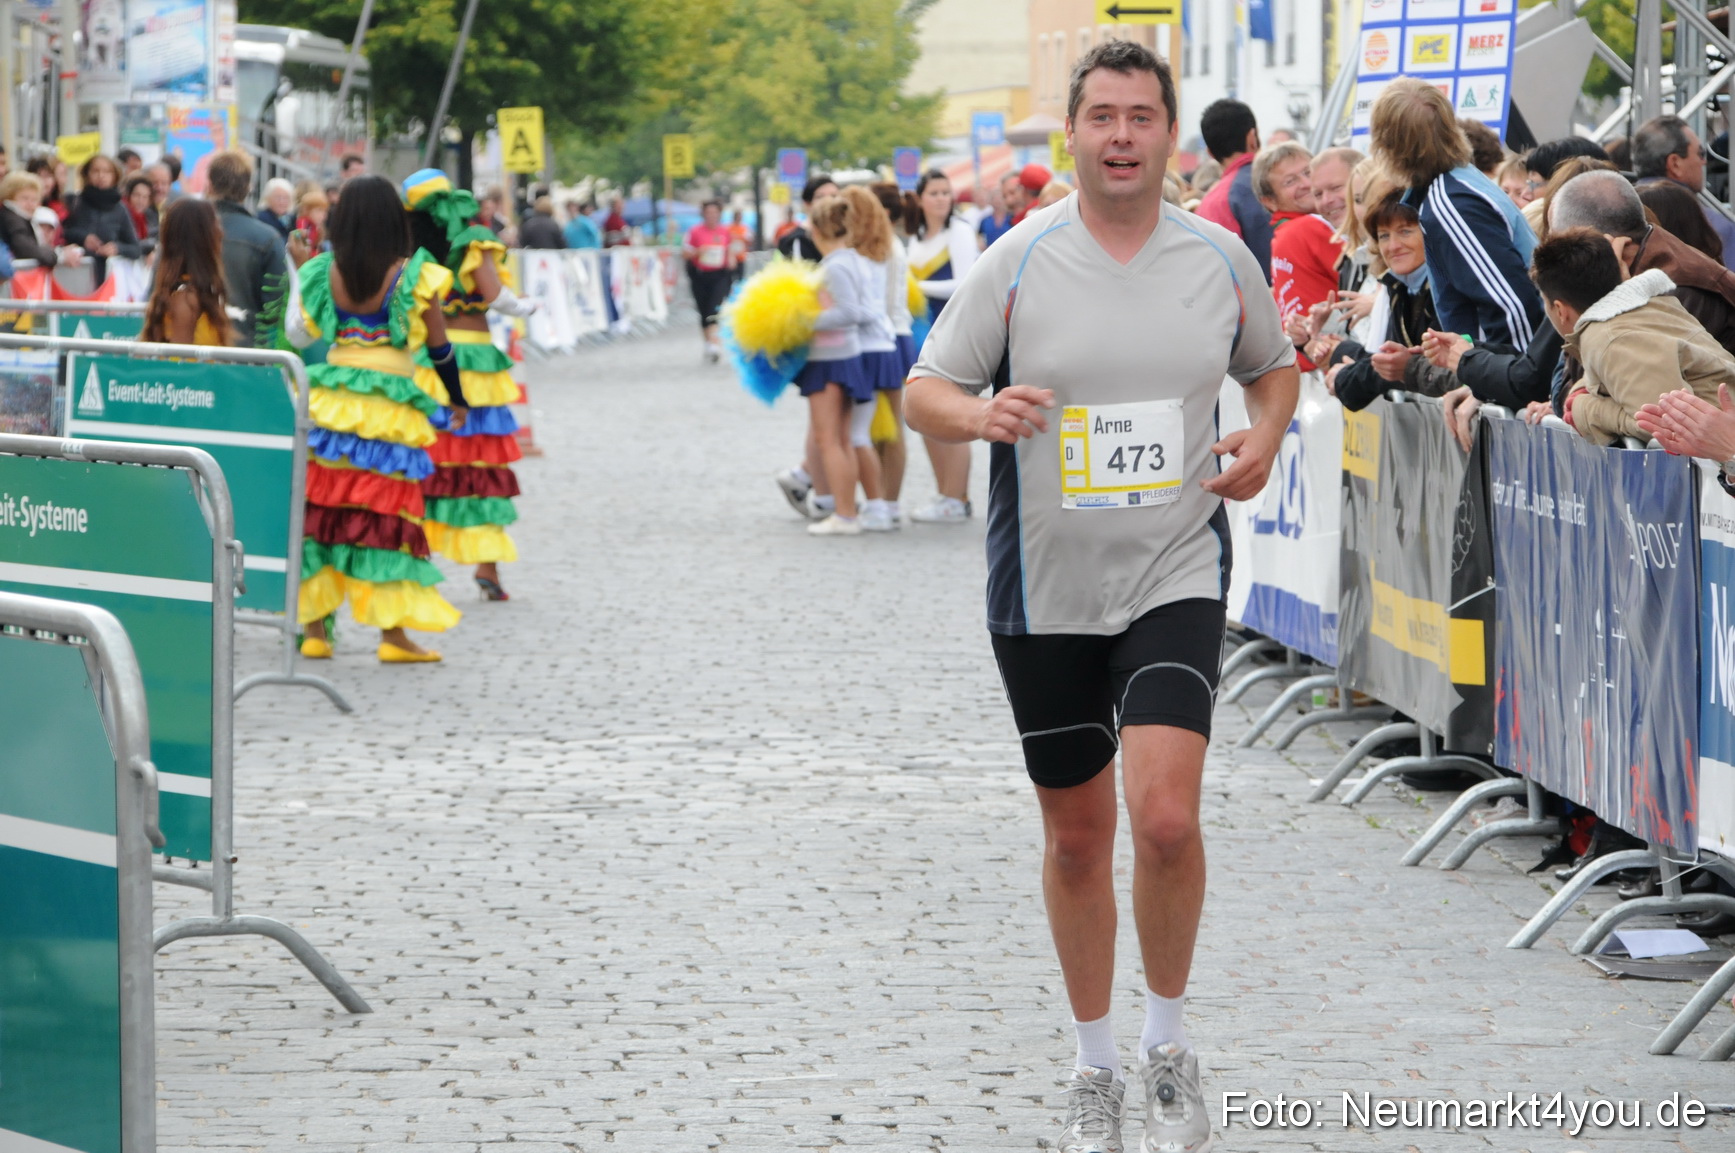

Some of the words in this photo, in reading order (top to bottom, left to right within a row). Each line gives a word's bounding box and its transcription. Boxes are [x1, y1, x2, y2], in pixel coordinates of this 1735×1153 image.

[1468, 34, 1504, 49] MERZ
[510, 127, 532, 156] A
[108, 379, 215, 412] Event-Leit-Systeme
[1094, 414, 1132, 434] Arne
[1065, 446, 1074, 461] D
[1107, 443, 1165, 474] 473
[1142, 486, 1181, 499] PFLEIDERER
